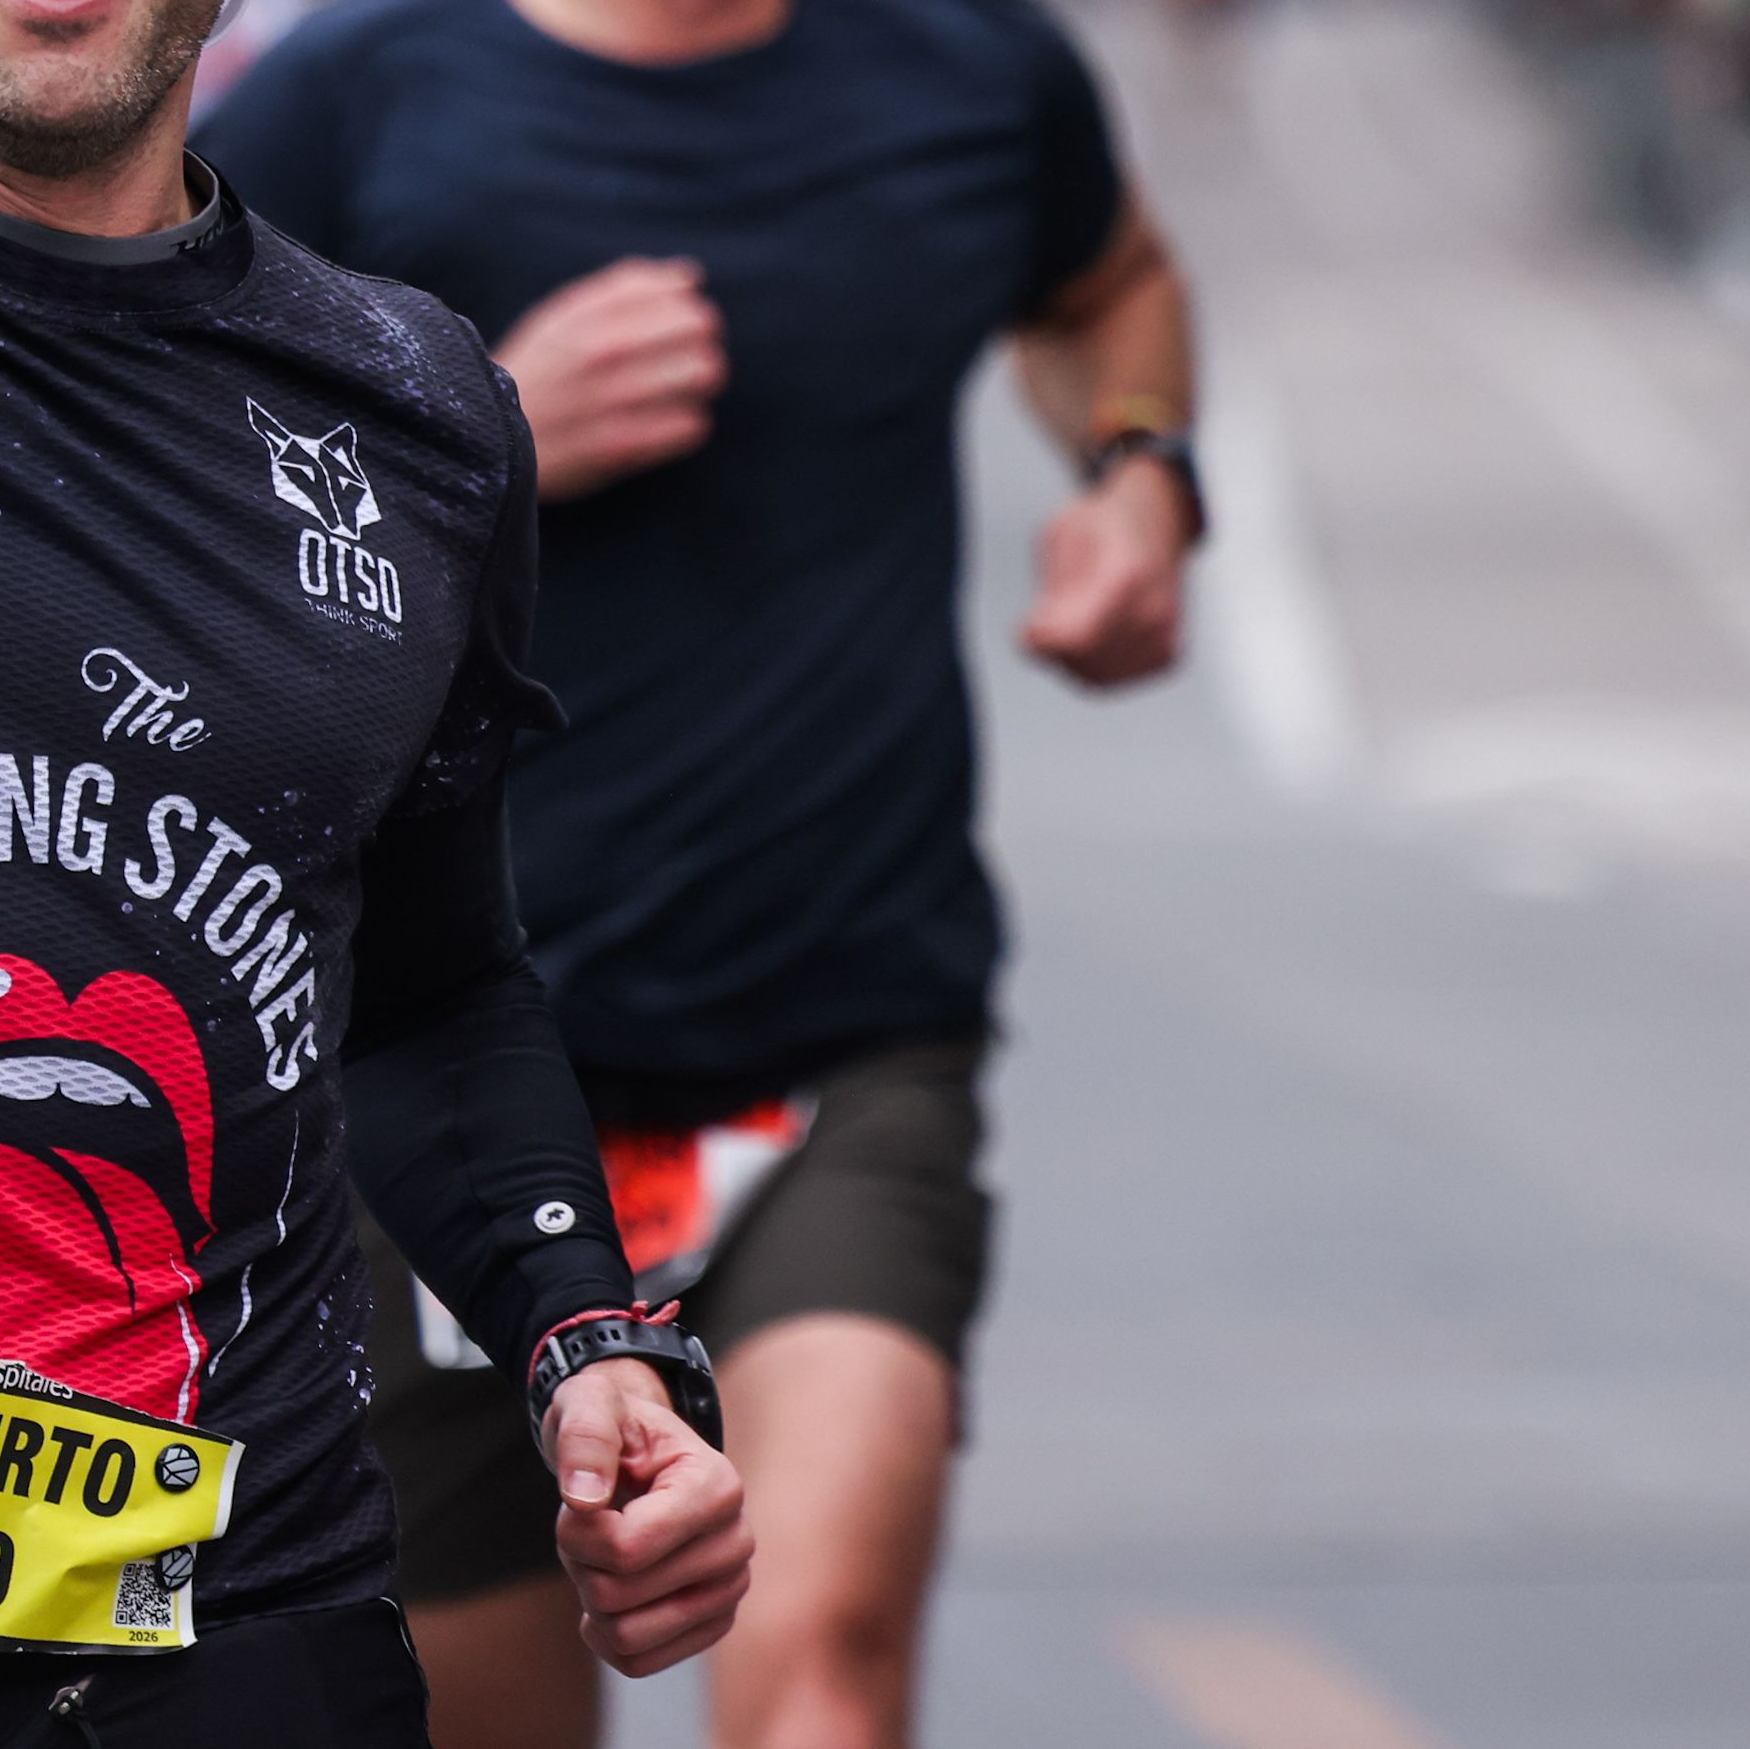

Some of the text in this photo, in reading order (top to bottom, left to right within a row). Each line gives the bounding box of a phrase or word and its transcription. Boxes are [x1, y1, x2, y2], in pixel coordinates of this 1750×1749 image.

[298, 528, 402, 624] OTSO
[359, 615, 403, 646] SPORT
[81, 647, 212, 751] The
[124, 793, 319, 1092] STONES
[129, 1631, 159, 1643] 2026
